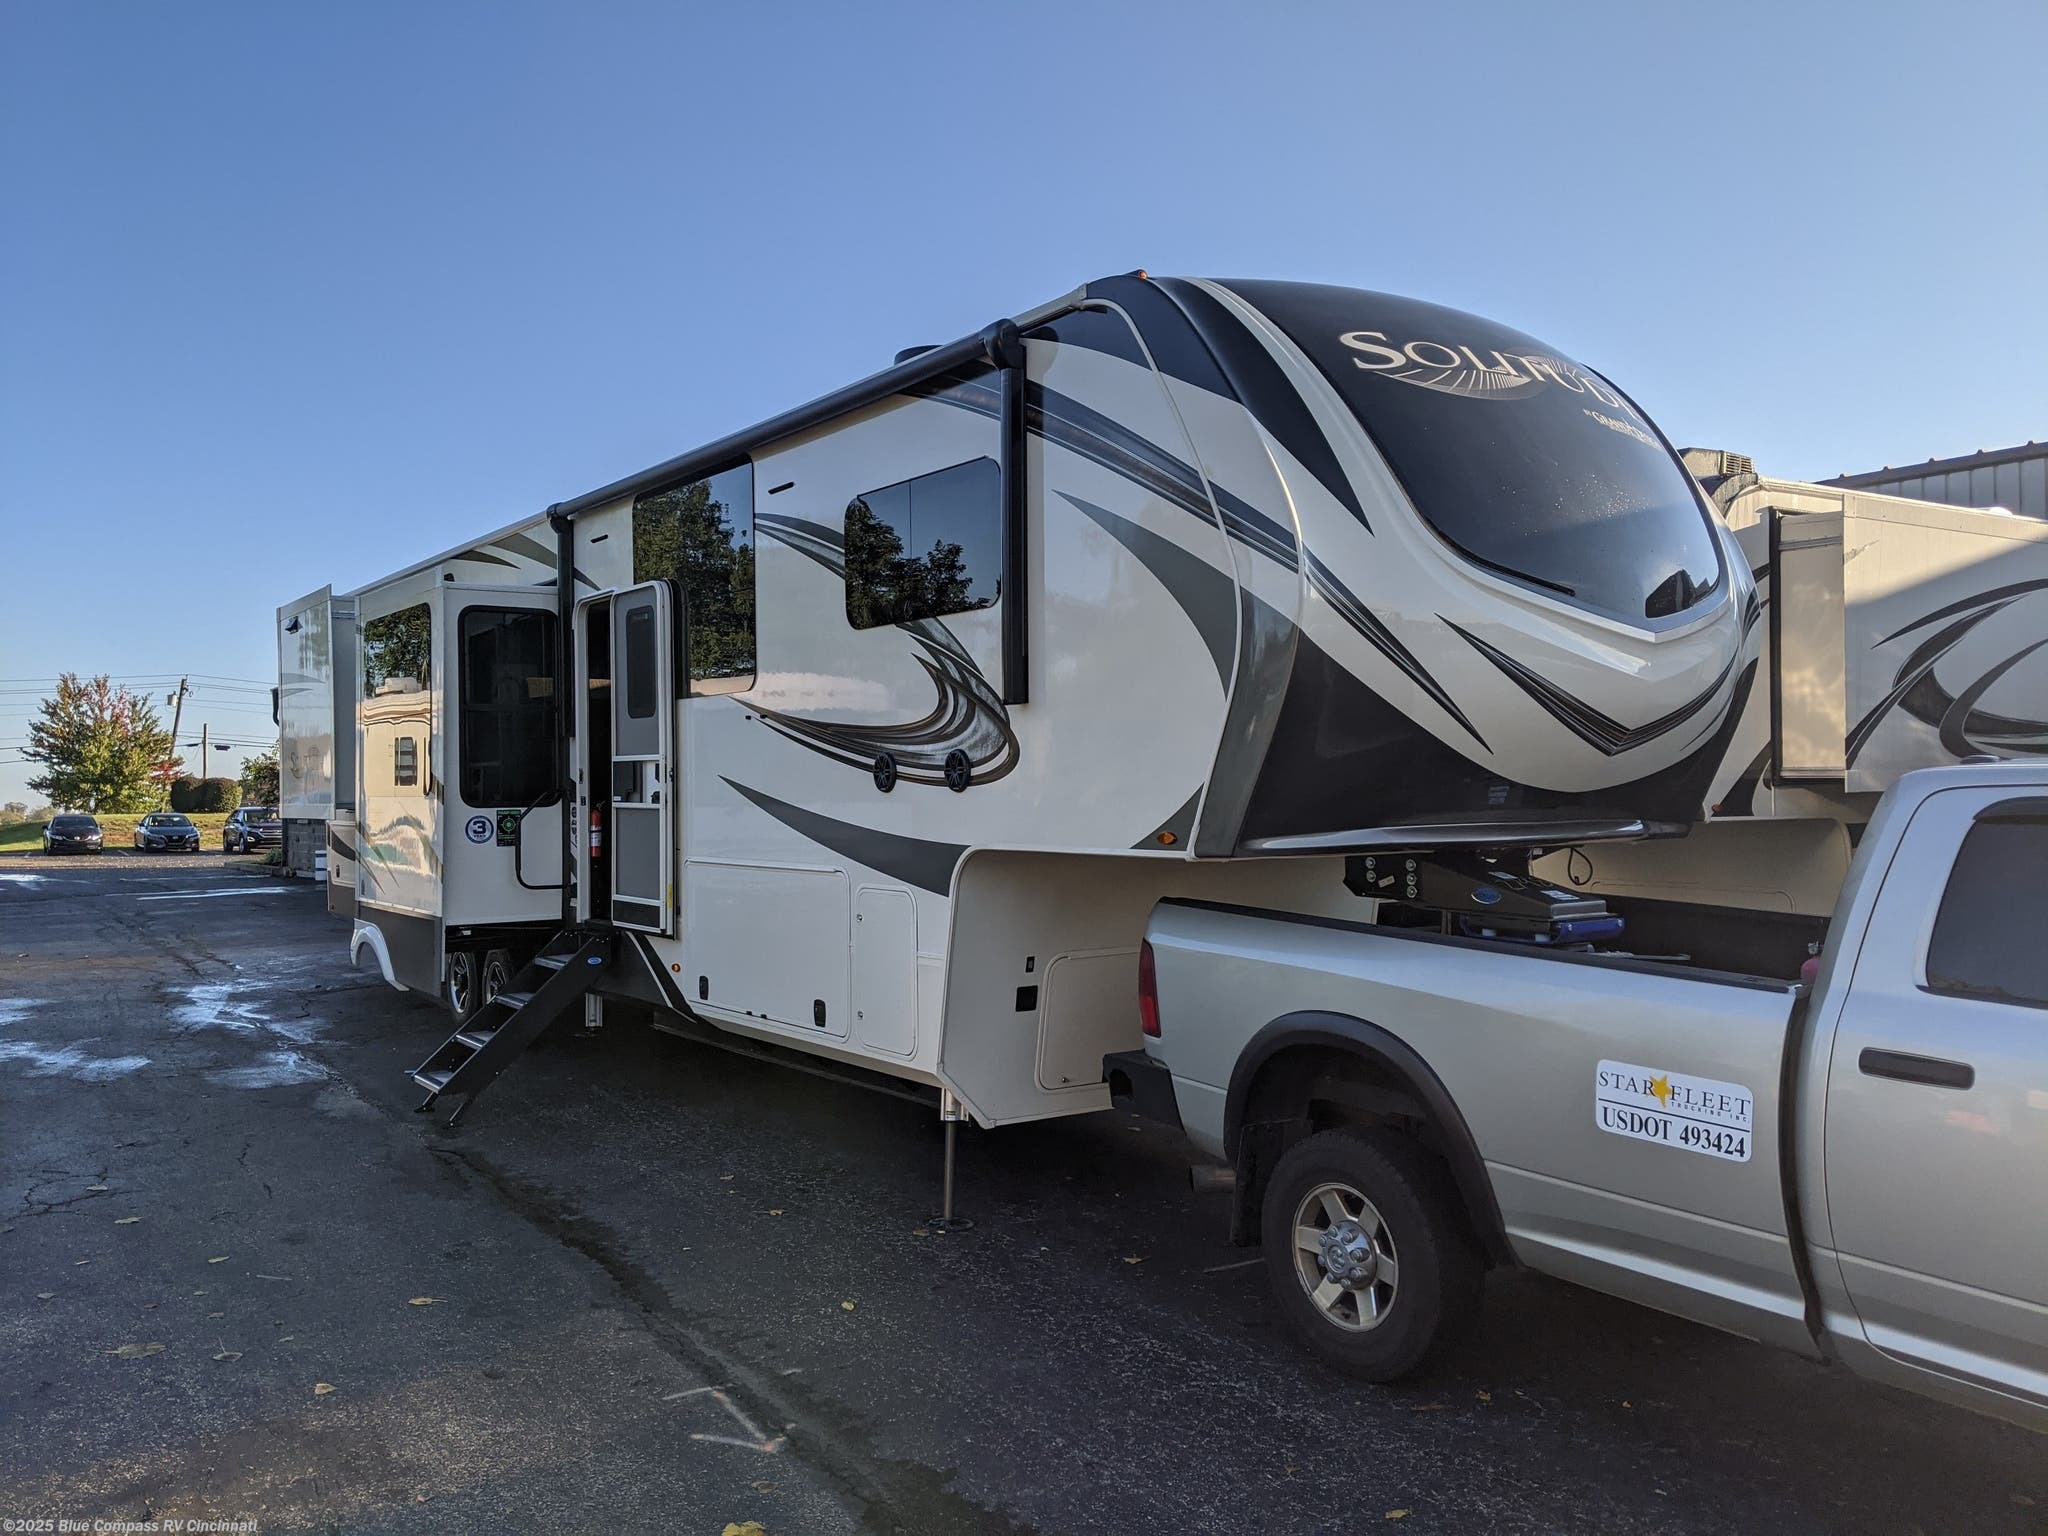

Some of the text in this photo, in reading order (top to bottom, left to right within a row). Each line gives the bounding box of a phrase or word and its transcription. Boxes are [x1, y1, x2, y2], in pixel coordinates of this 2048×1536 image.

[472, 820, 487, 834] 3
[1598, 1071, 1750, 1116] STAR FLEET
[1671, 1101, 1721, 1117] TRUCKING
[1603, 1106, 1745, 1158] USDOT 493424
